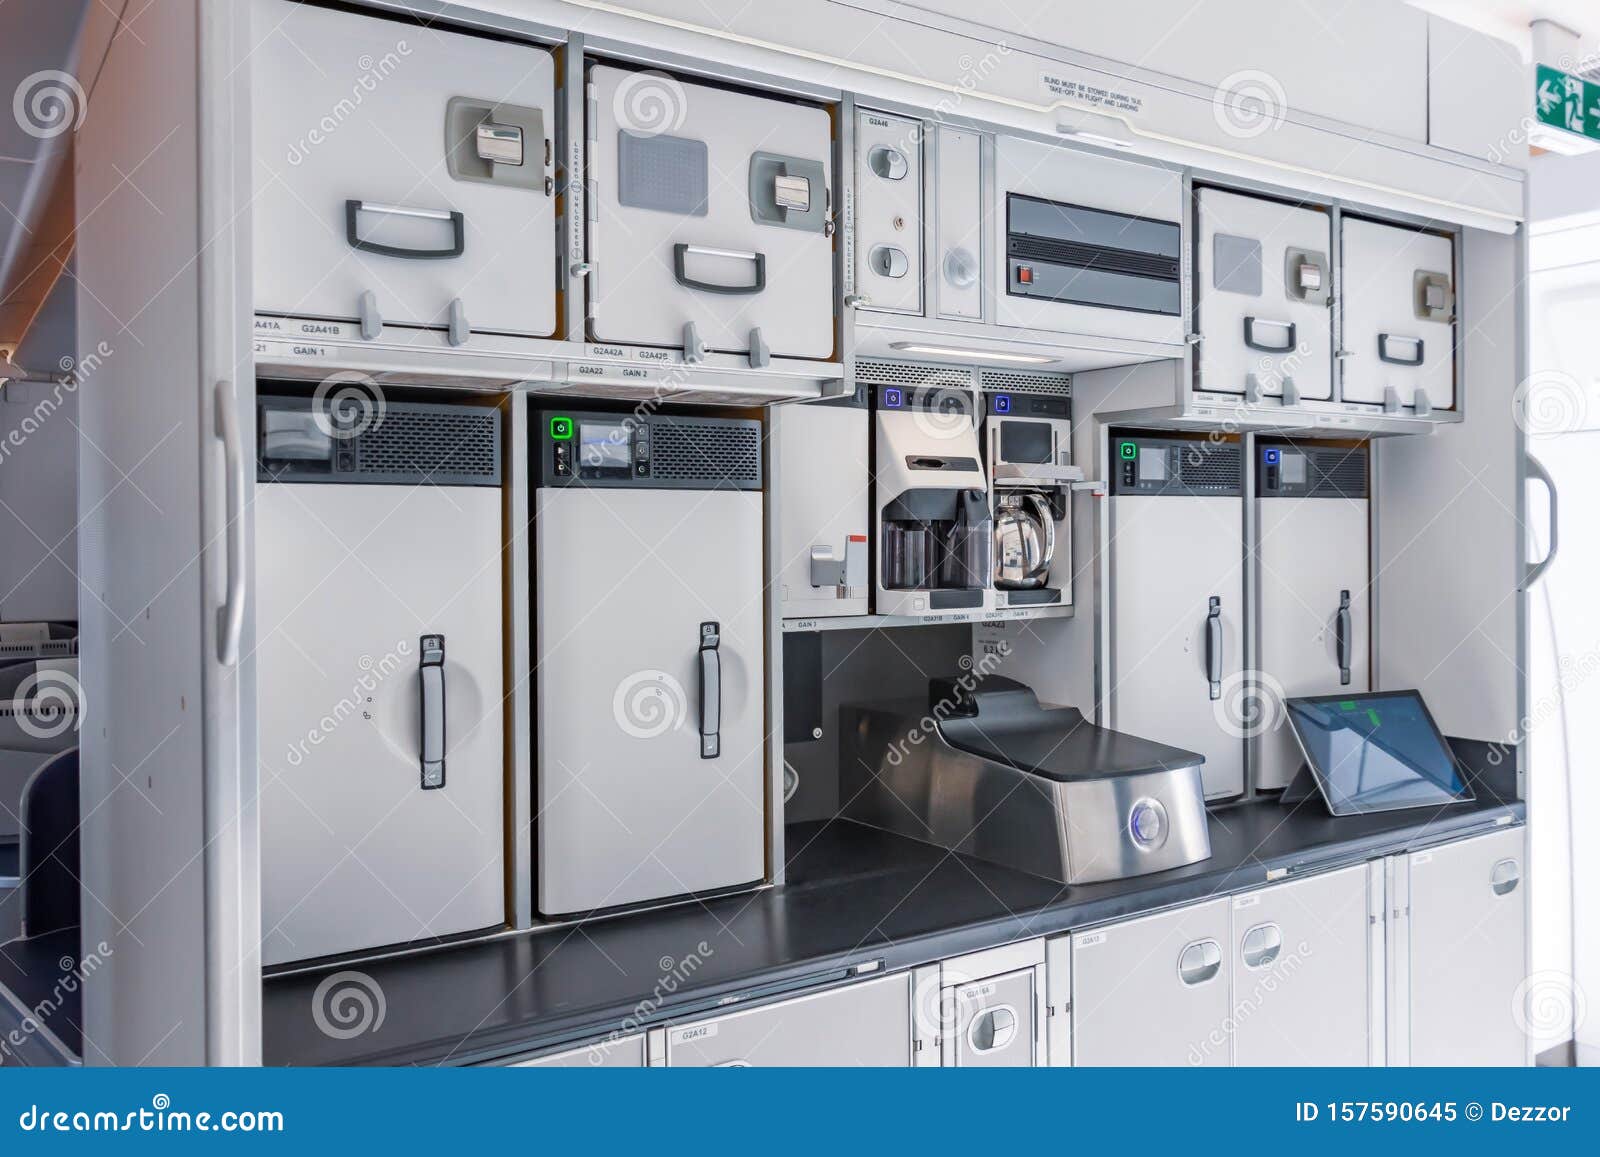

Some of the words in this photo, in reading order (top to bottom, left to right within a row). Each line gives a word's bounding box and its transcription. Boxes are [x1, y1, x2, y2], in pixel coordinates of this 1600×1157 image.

[301, 324, 340, 335] G2A41B
[293, 347, 317, 355] GAIN
[593, 346, 624, 357] G2A42A
[579, 366, 603, 375] G2A22
[622, 368, 641, 377] GAIN
